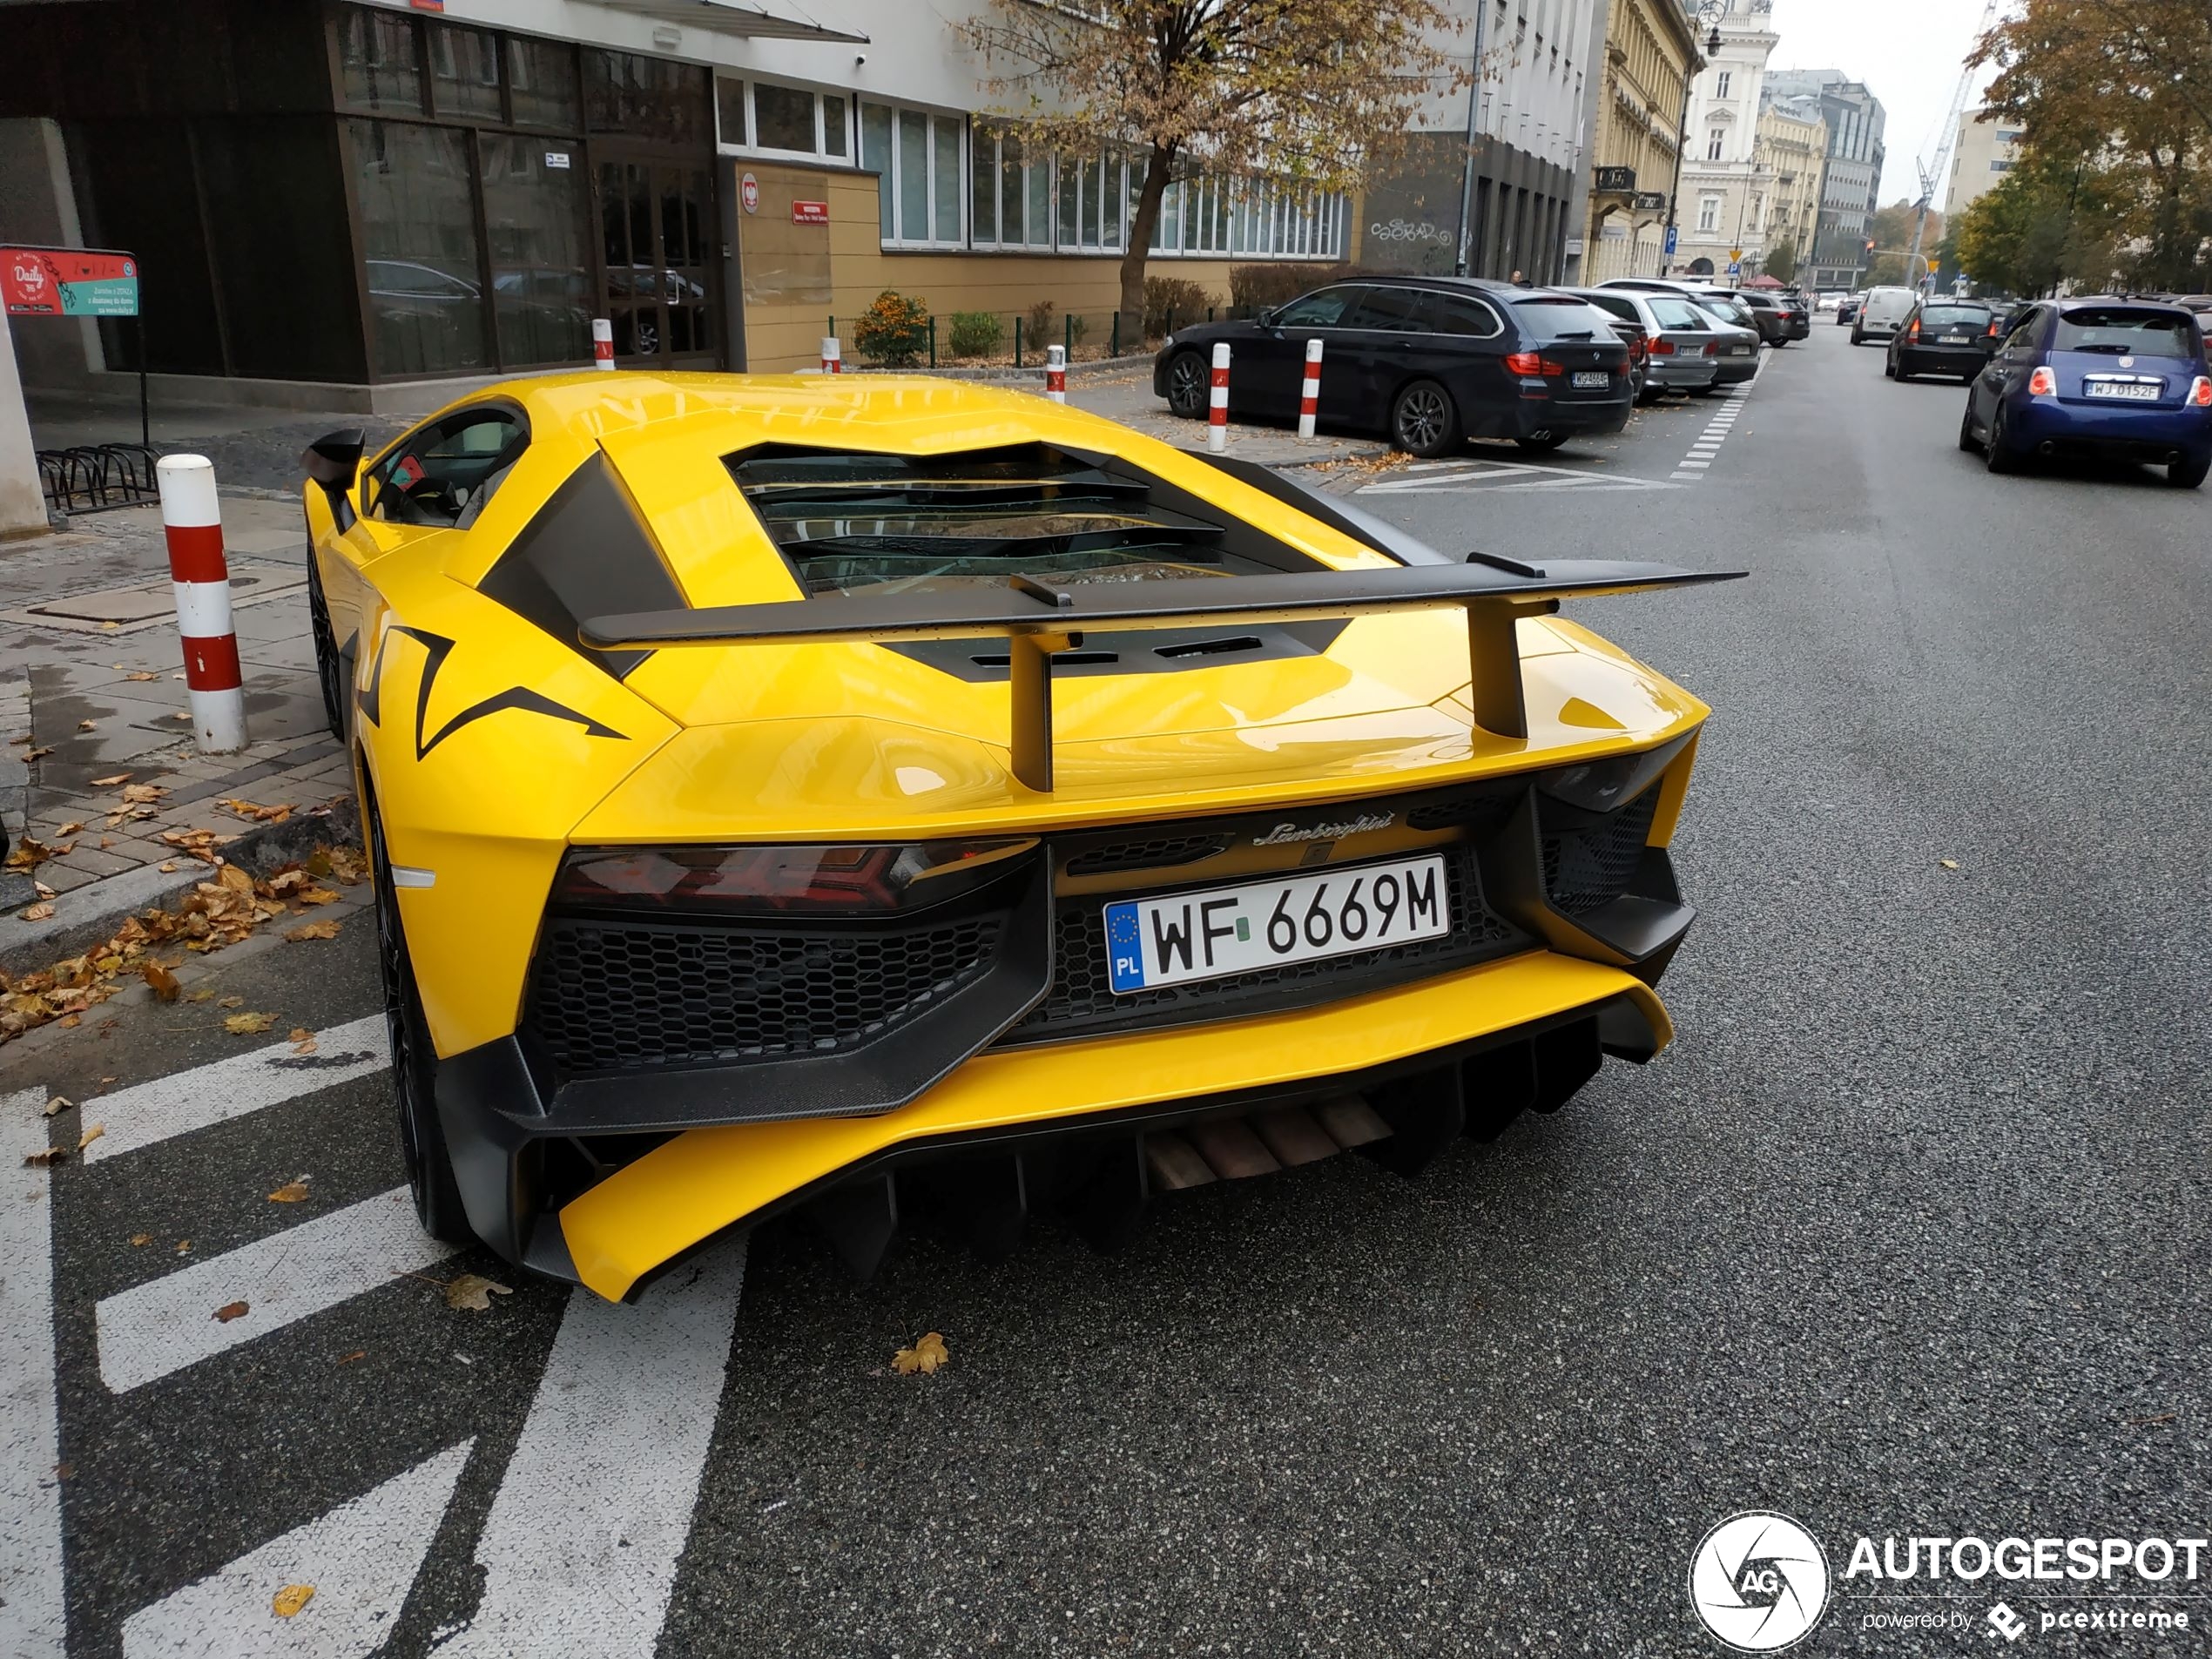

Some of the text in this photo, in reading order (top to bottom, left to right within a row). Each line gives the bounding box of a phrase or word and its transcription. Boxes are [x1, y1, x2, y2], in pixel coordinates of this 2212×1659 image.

[14, 265, 44, 289] Daily
[2094, 383, 2157, 397] WJ 0152F
[1252, 809, 1396, 847] Lamborghini
[1150, 866, 1439, 974] WF 6669M
[1116, 956, 1139, 977] PL
